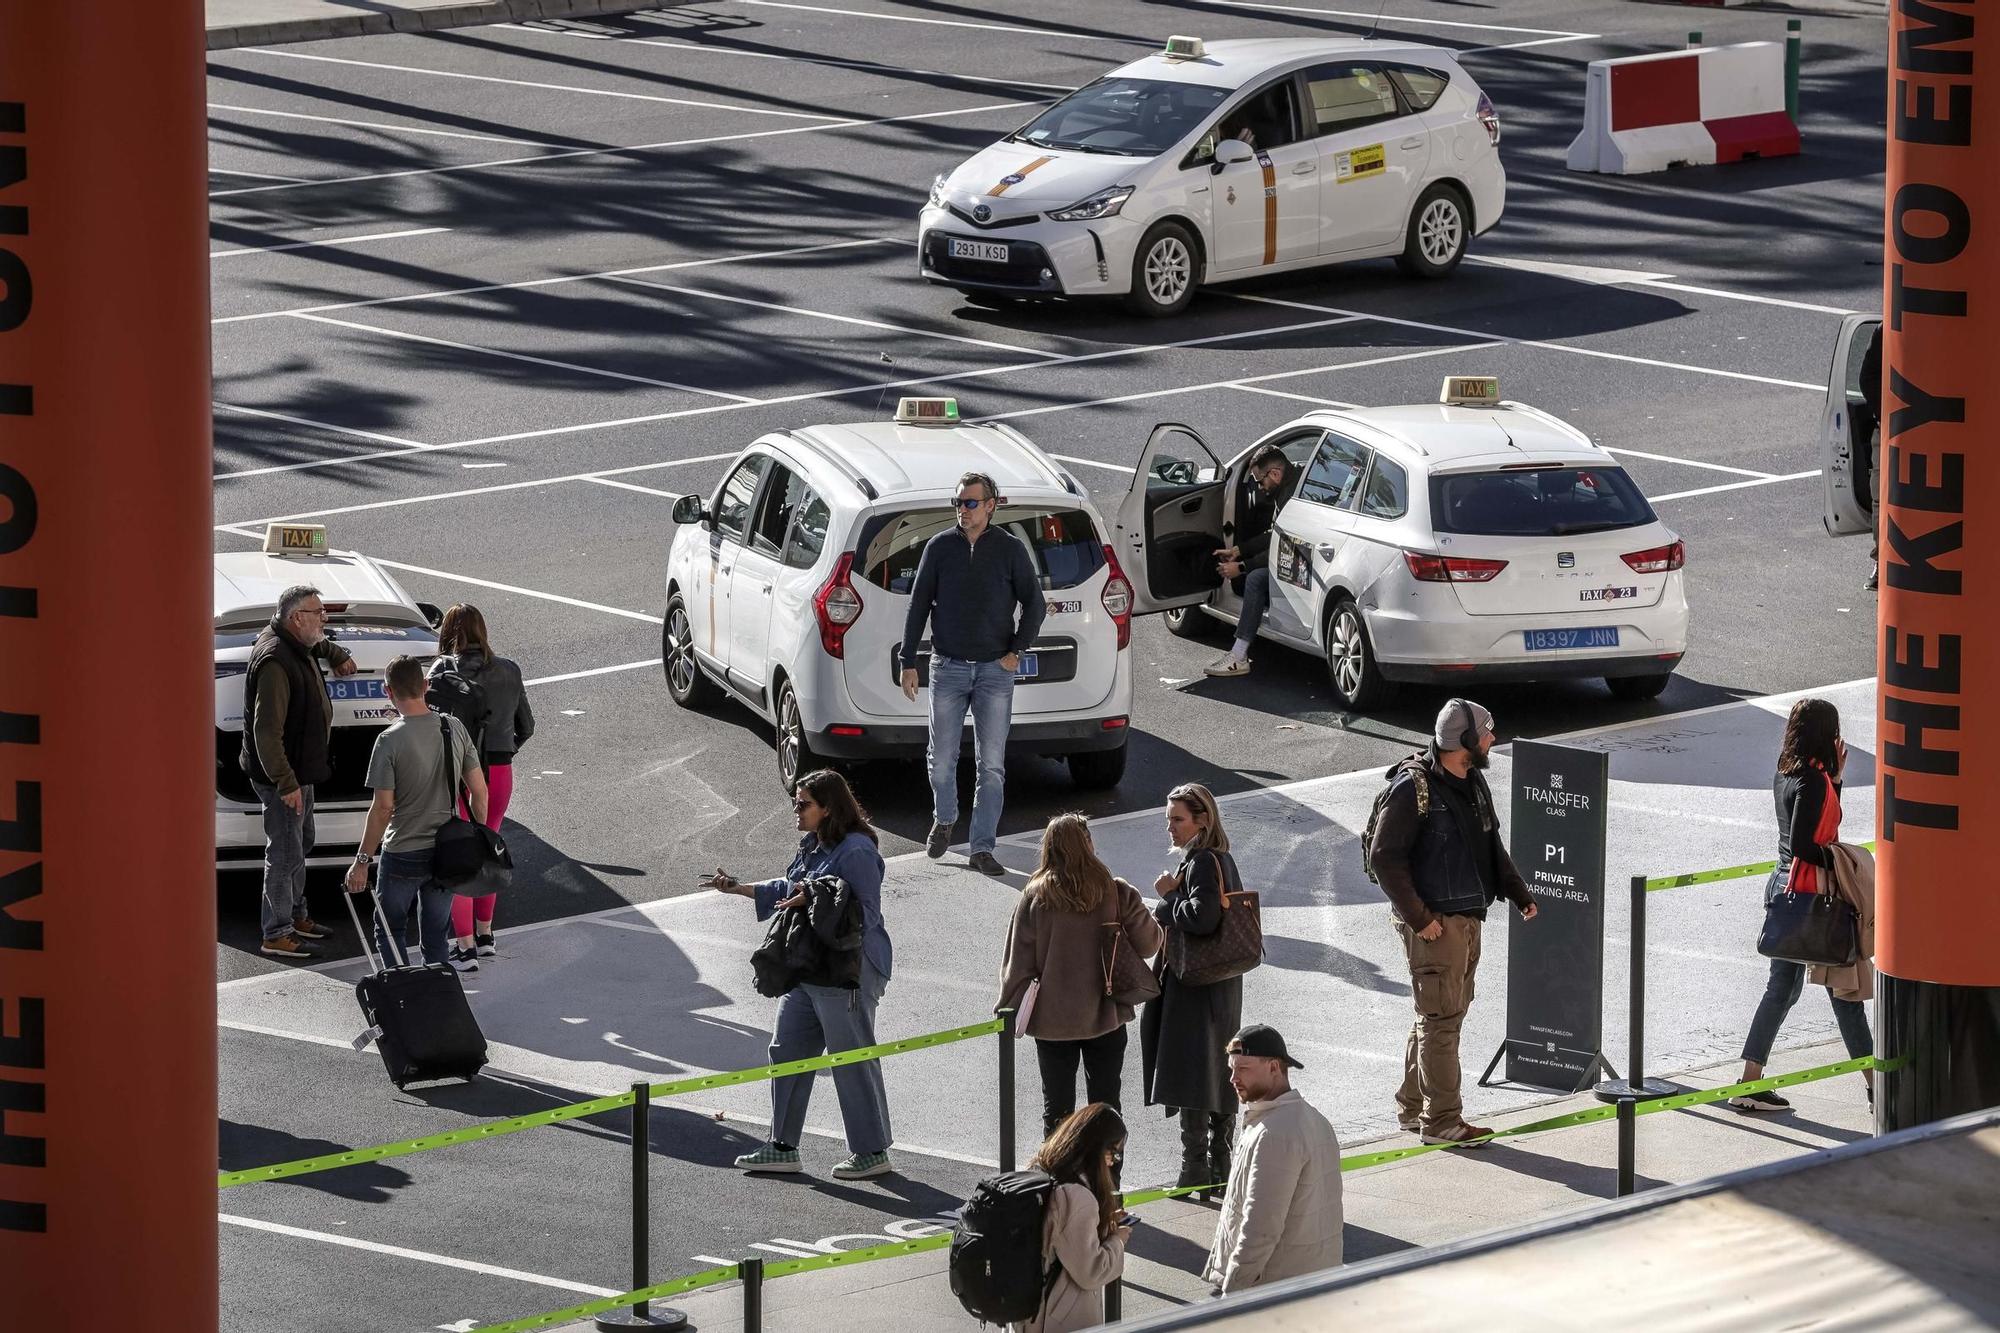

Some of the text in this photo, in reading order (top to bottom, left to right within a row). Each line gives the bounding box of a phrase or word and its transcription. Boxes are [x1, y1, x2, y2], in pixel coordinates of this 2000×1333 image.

[956, 243, 1006, 260] 2931 KSD
[1890, 183, 1970, 332] TO
[1460, 381, 1486, 397] TAXI
[1886, 366, 1966, 596] KEY
[284, 529, 312, 547] TAXI
[1050, 525, 1056, 538] 1
[1581, 589, 1603, 601] TAXI
[1620, 588, 1632, 598] 23
[1062, 601, 1080, 612] 260
[1536, 627, 1618, 647] 8397 JNN
[354, 709, 381, 719] TAXI
[1884, 626, 1961, 842] THE
[1523, 786, 1590, 809] TRANSFER
[1546, 807, 1566, 817] CLASS
[1545, 844, 1566, 864] P1
[1534, 871, 1575, 886] PRIVATE
[1564, 890, 1590, 903] AREA
[1517, 1054, 1538, 1064] Premium
[1550, 1060, 1564, 1068] Green
[1564, 1062, 1585, 1072] Mobility
